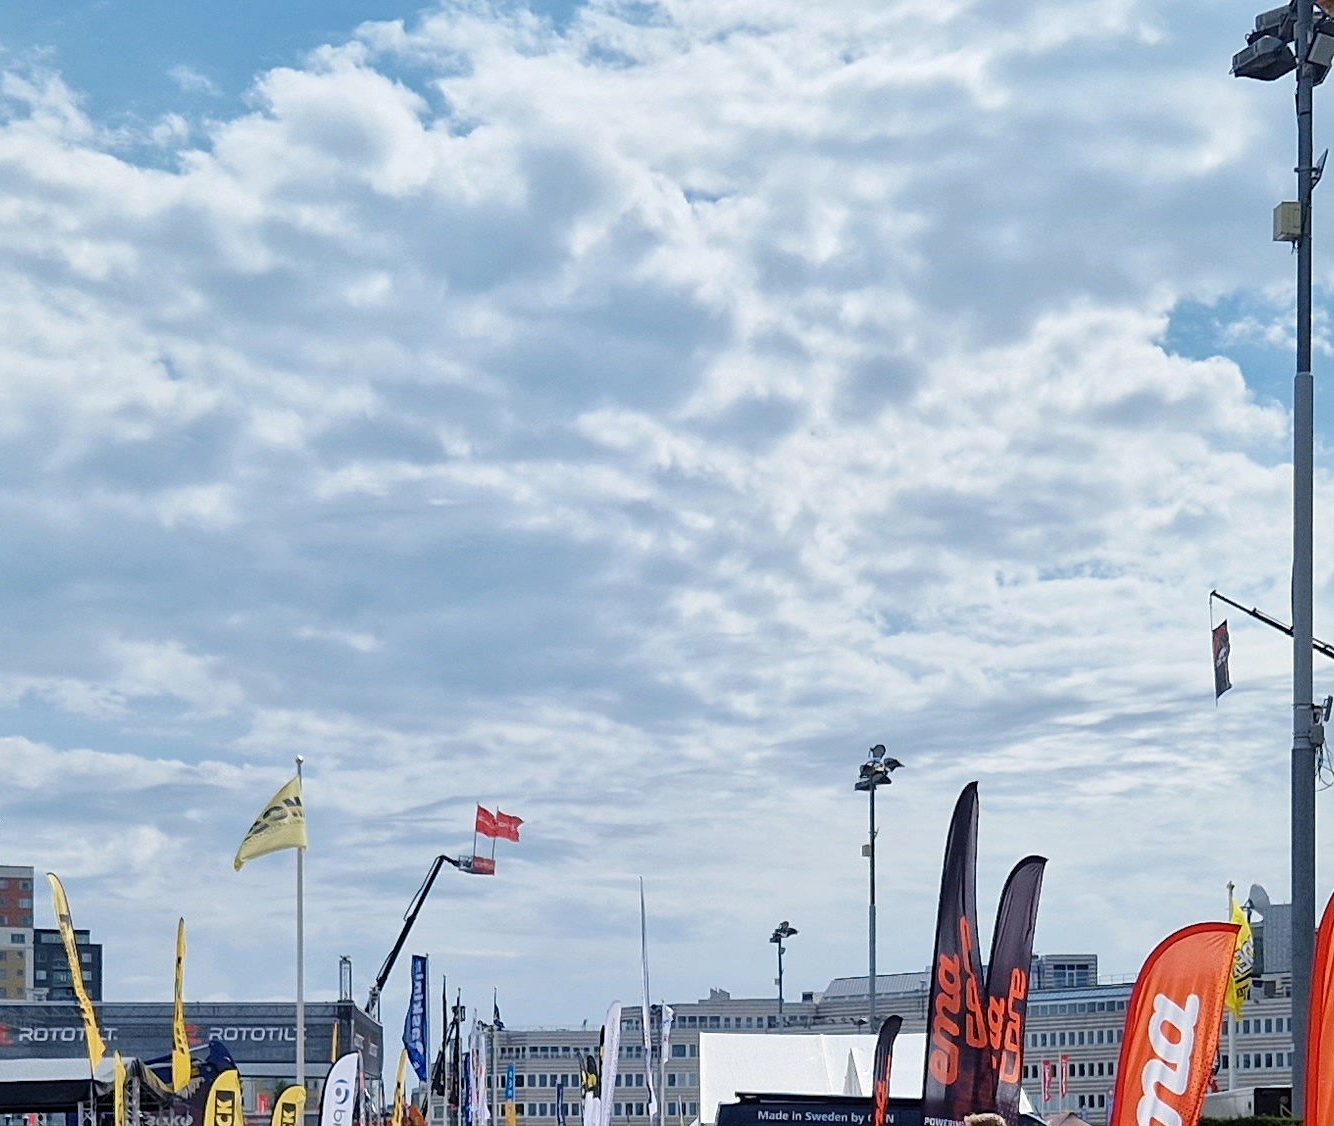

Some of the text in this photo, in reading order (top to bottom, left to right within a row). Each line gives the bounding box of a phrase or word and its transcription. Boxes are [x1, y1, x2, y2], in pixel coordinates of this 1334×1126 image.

[929, 953, 961, 1086] ema
[18, 1027, 118, 1042] ROTOTT
[757, 1110, 789, 1121] Made
[791, 1110, 802, 1121] in
[804, 1111, 848, 1122] Sweden
[851, 1111, 864, 1125] by
